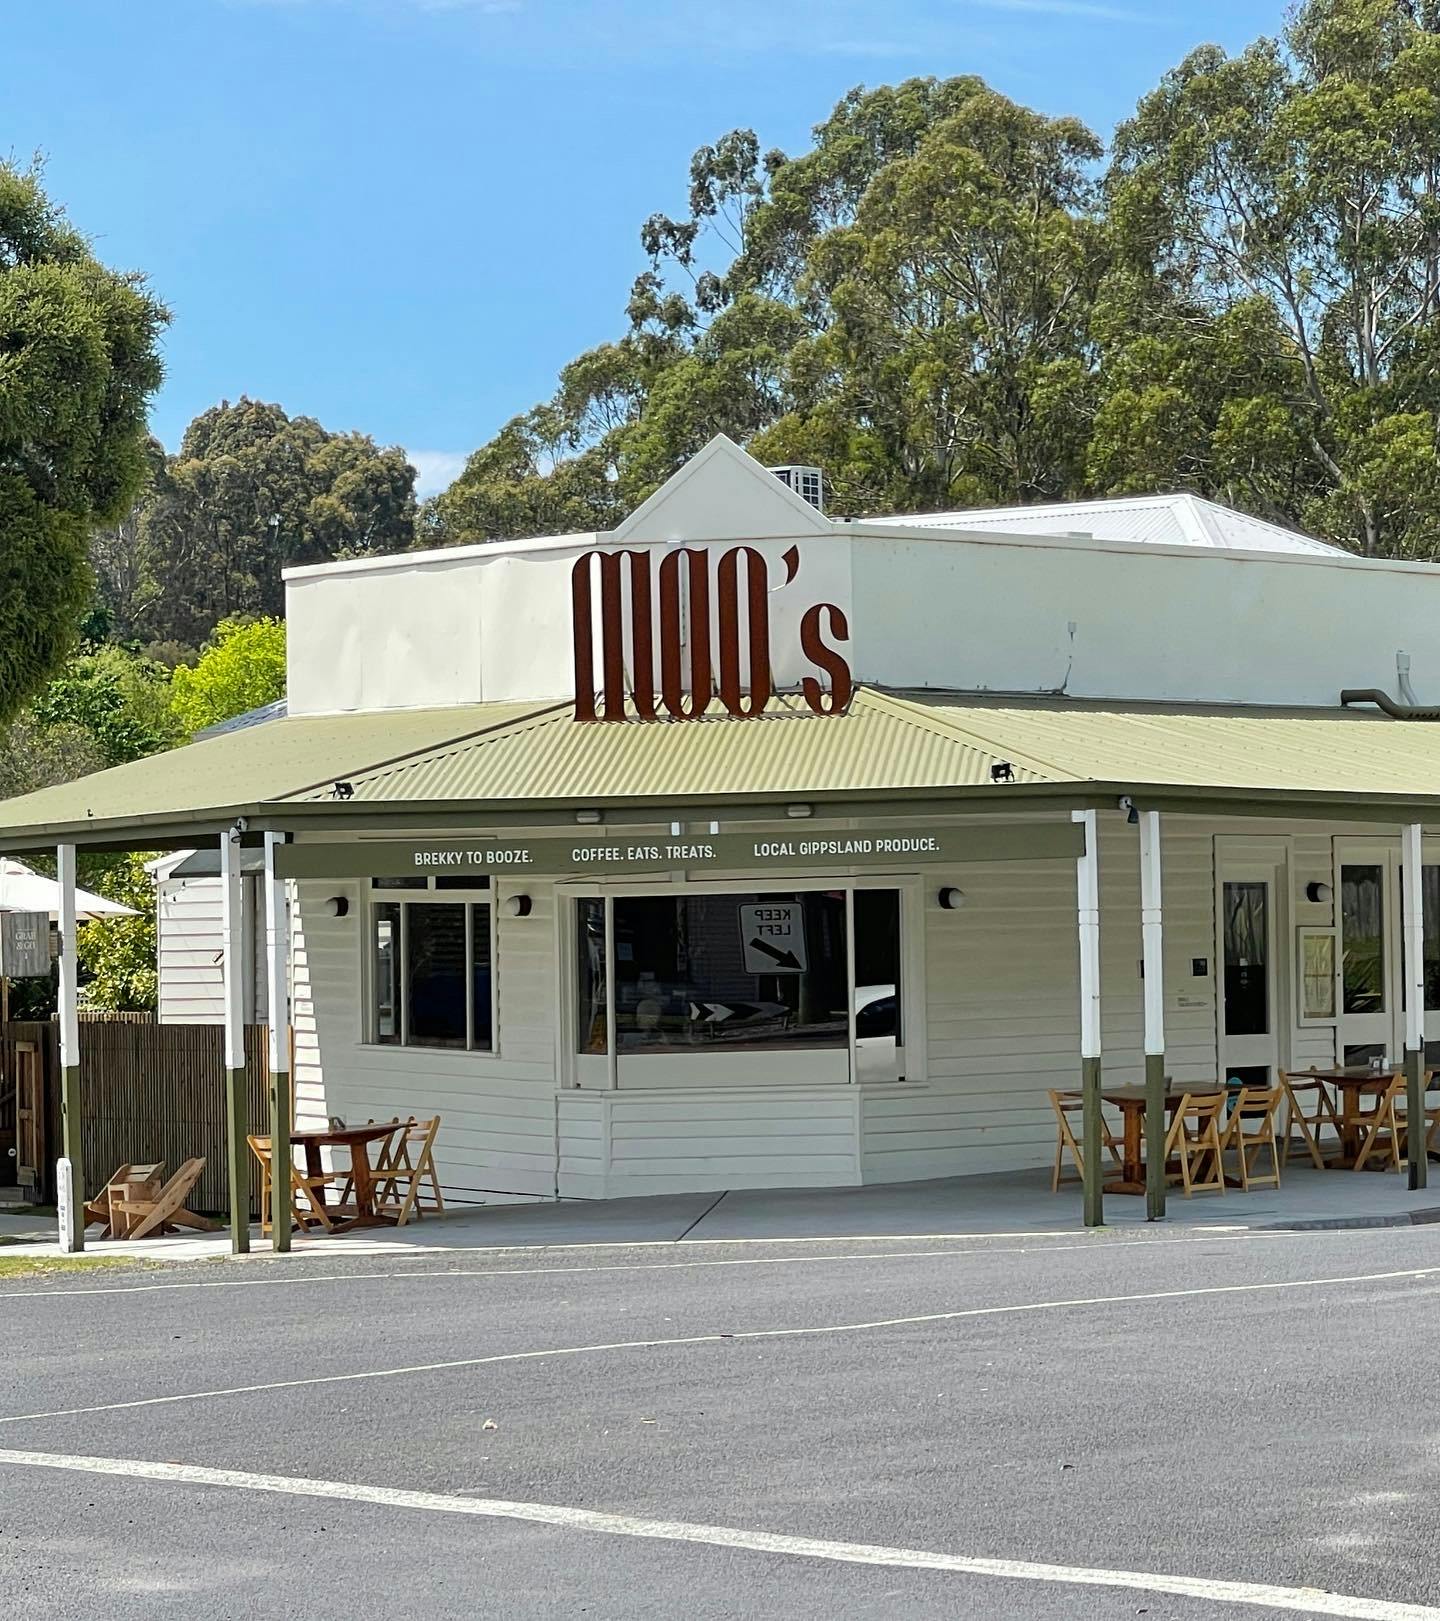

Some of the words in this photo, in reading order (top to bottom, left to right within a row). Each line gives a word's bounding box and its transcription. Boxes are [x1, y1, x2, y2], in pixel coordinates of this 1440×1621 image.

[572, 847, 624, 862] COFFEE.
[627, 846, 663, 861] EATS.
[665, 845, 717, 860] TREATS.
[754, 842, 797, 858] LOCAL
[799, 840, 873, 856] GIPPSLAND
[876, 838, 940, 853] PRODUCE.
[414, 851, 463, 866] BREKKY
[466, 851, 482, 865] TO
[486, 849, 534, 865] BOOZE.
